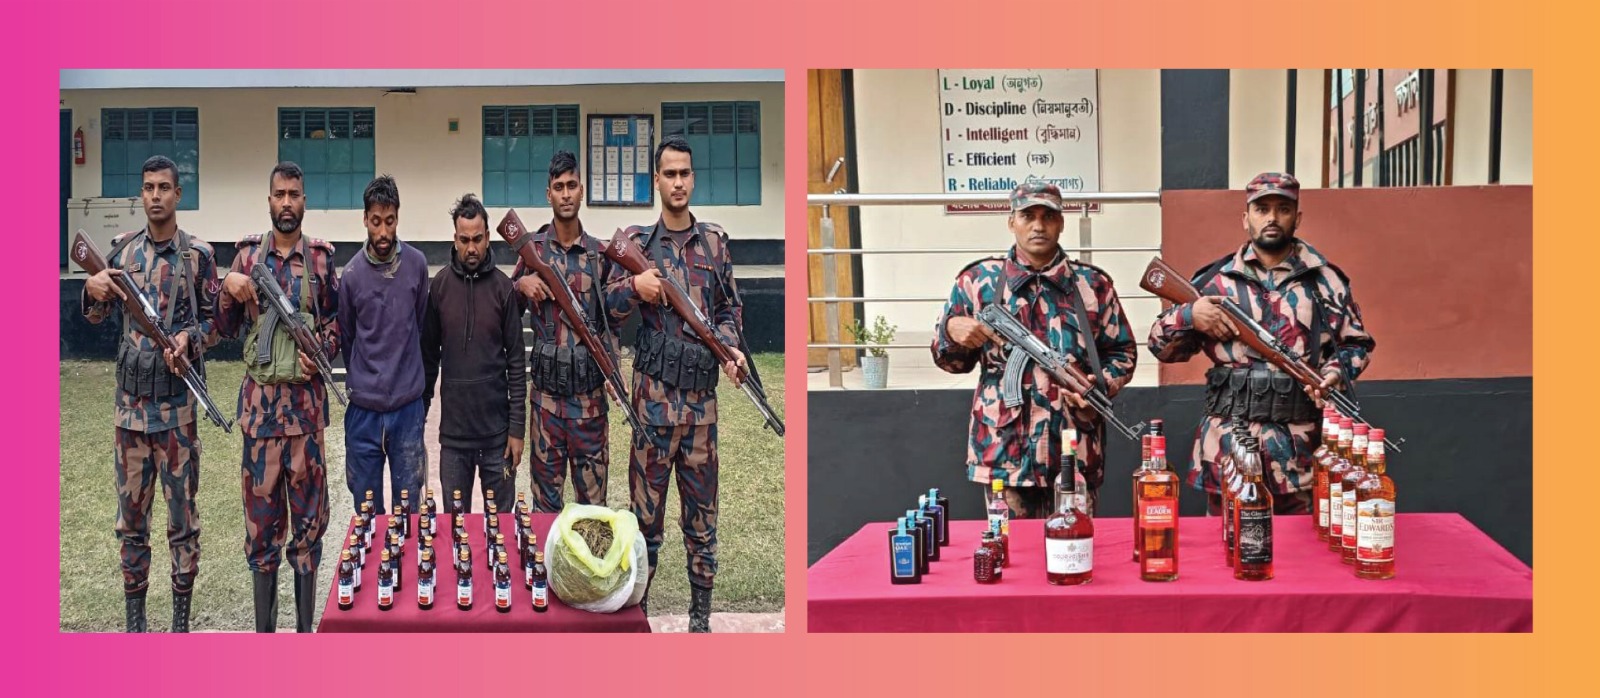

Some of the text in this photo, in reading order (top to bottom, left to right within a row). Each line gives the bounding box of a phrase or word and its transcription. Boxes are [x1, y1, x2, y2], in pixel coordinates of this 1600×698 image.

[943, 76, 951, 90] L
[962, 76, 994, 93] Loyal
[944, 102, 954, 116] D
[965, 102, 1027, 118] Discipline
[945, 128, 950, 141] I
[966, 127, 1028, 144] Intelligent
[946, 153, 955, 166] E
[966, 152, 1016, 166] Efficient
[1026, 151, 1054, 168] (দক্ষ)
[948, 178, 957, 191] R
[968, 177, 1018, 191] Reliable
[1146, 507, 1172, 515] LEADER
